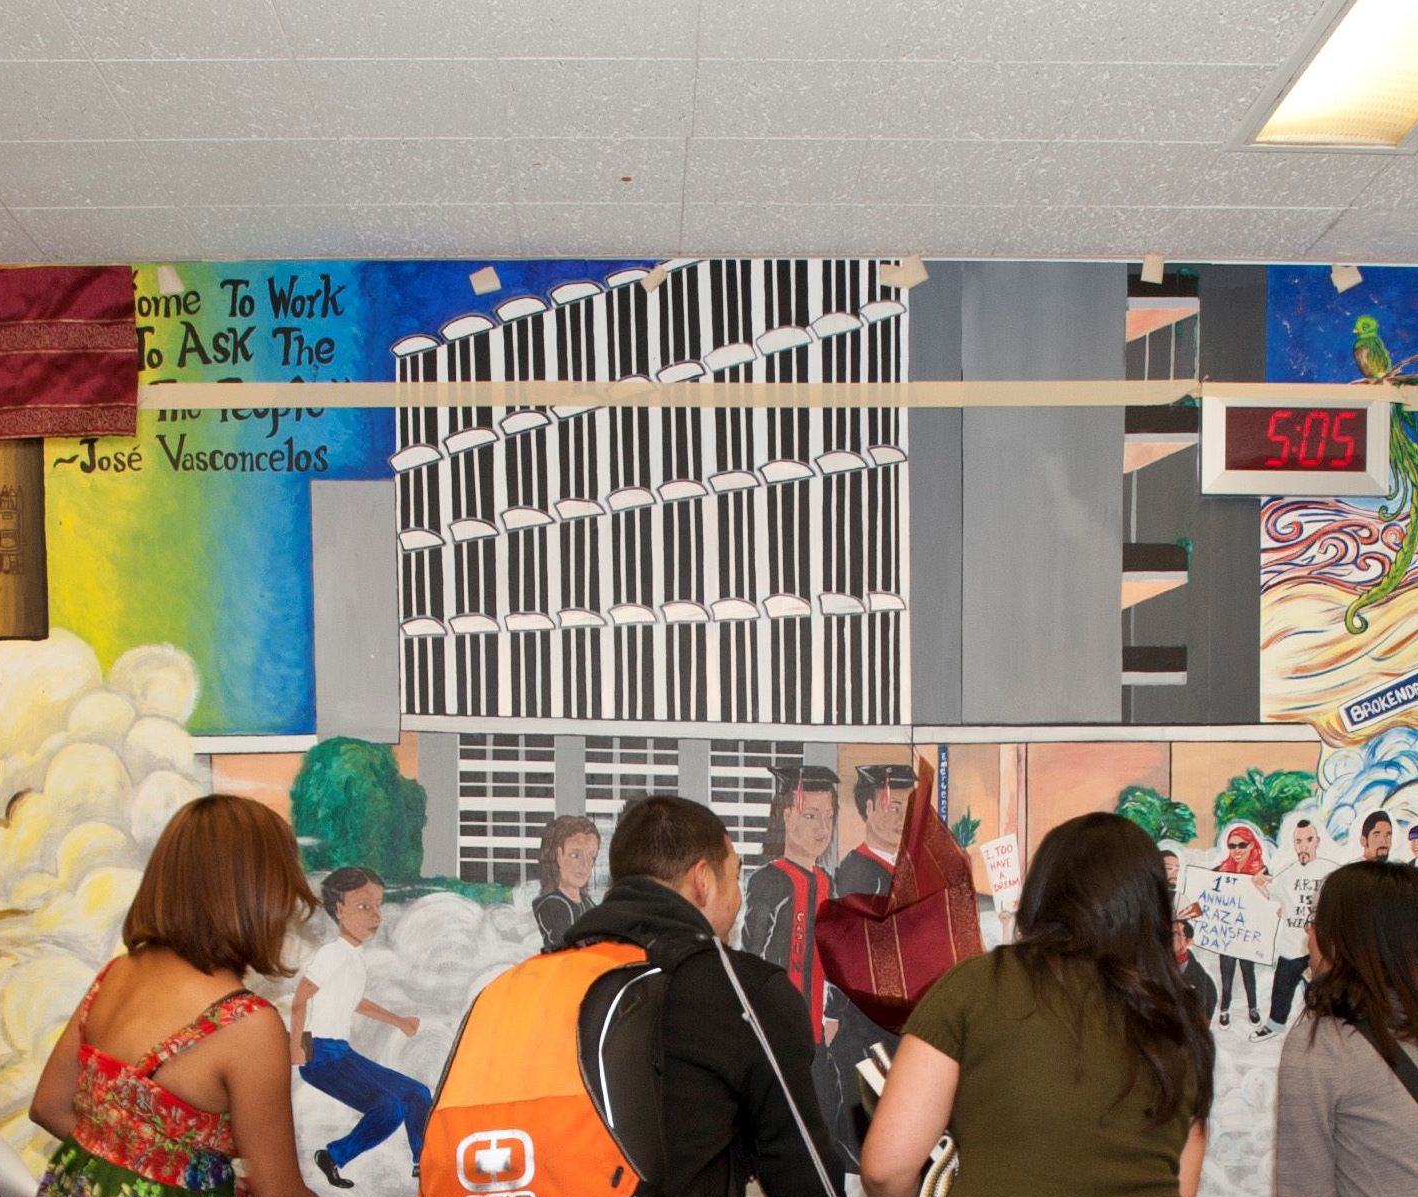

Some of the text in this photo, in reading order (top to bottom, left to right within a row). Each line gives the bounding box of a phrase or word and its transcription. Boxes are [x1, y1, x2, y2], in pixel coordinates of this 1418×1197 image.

[133, 273, 347, 319] ome To Work
[272, 326, 336, 367] The
[1264, 410, 1357, 468] 5:05
[156, 434, 329, 473] Vasconcelos
[995, 844, 1013, 857] TOO
[990, 859, 1012, 871] HAVE
[1293, 878, 1320, 892] ART
[1199, 890, 1245, 910] ANNUAL
[1300, 894, 1313, 905] IS
[1193, 919, 1262, 943] TRANSFER
[1201, 935, 1232, 952] DAY
